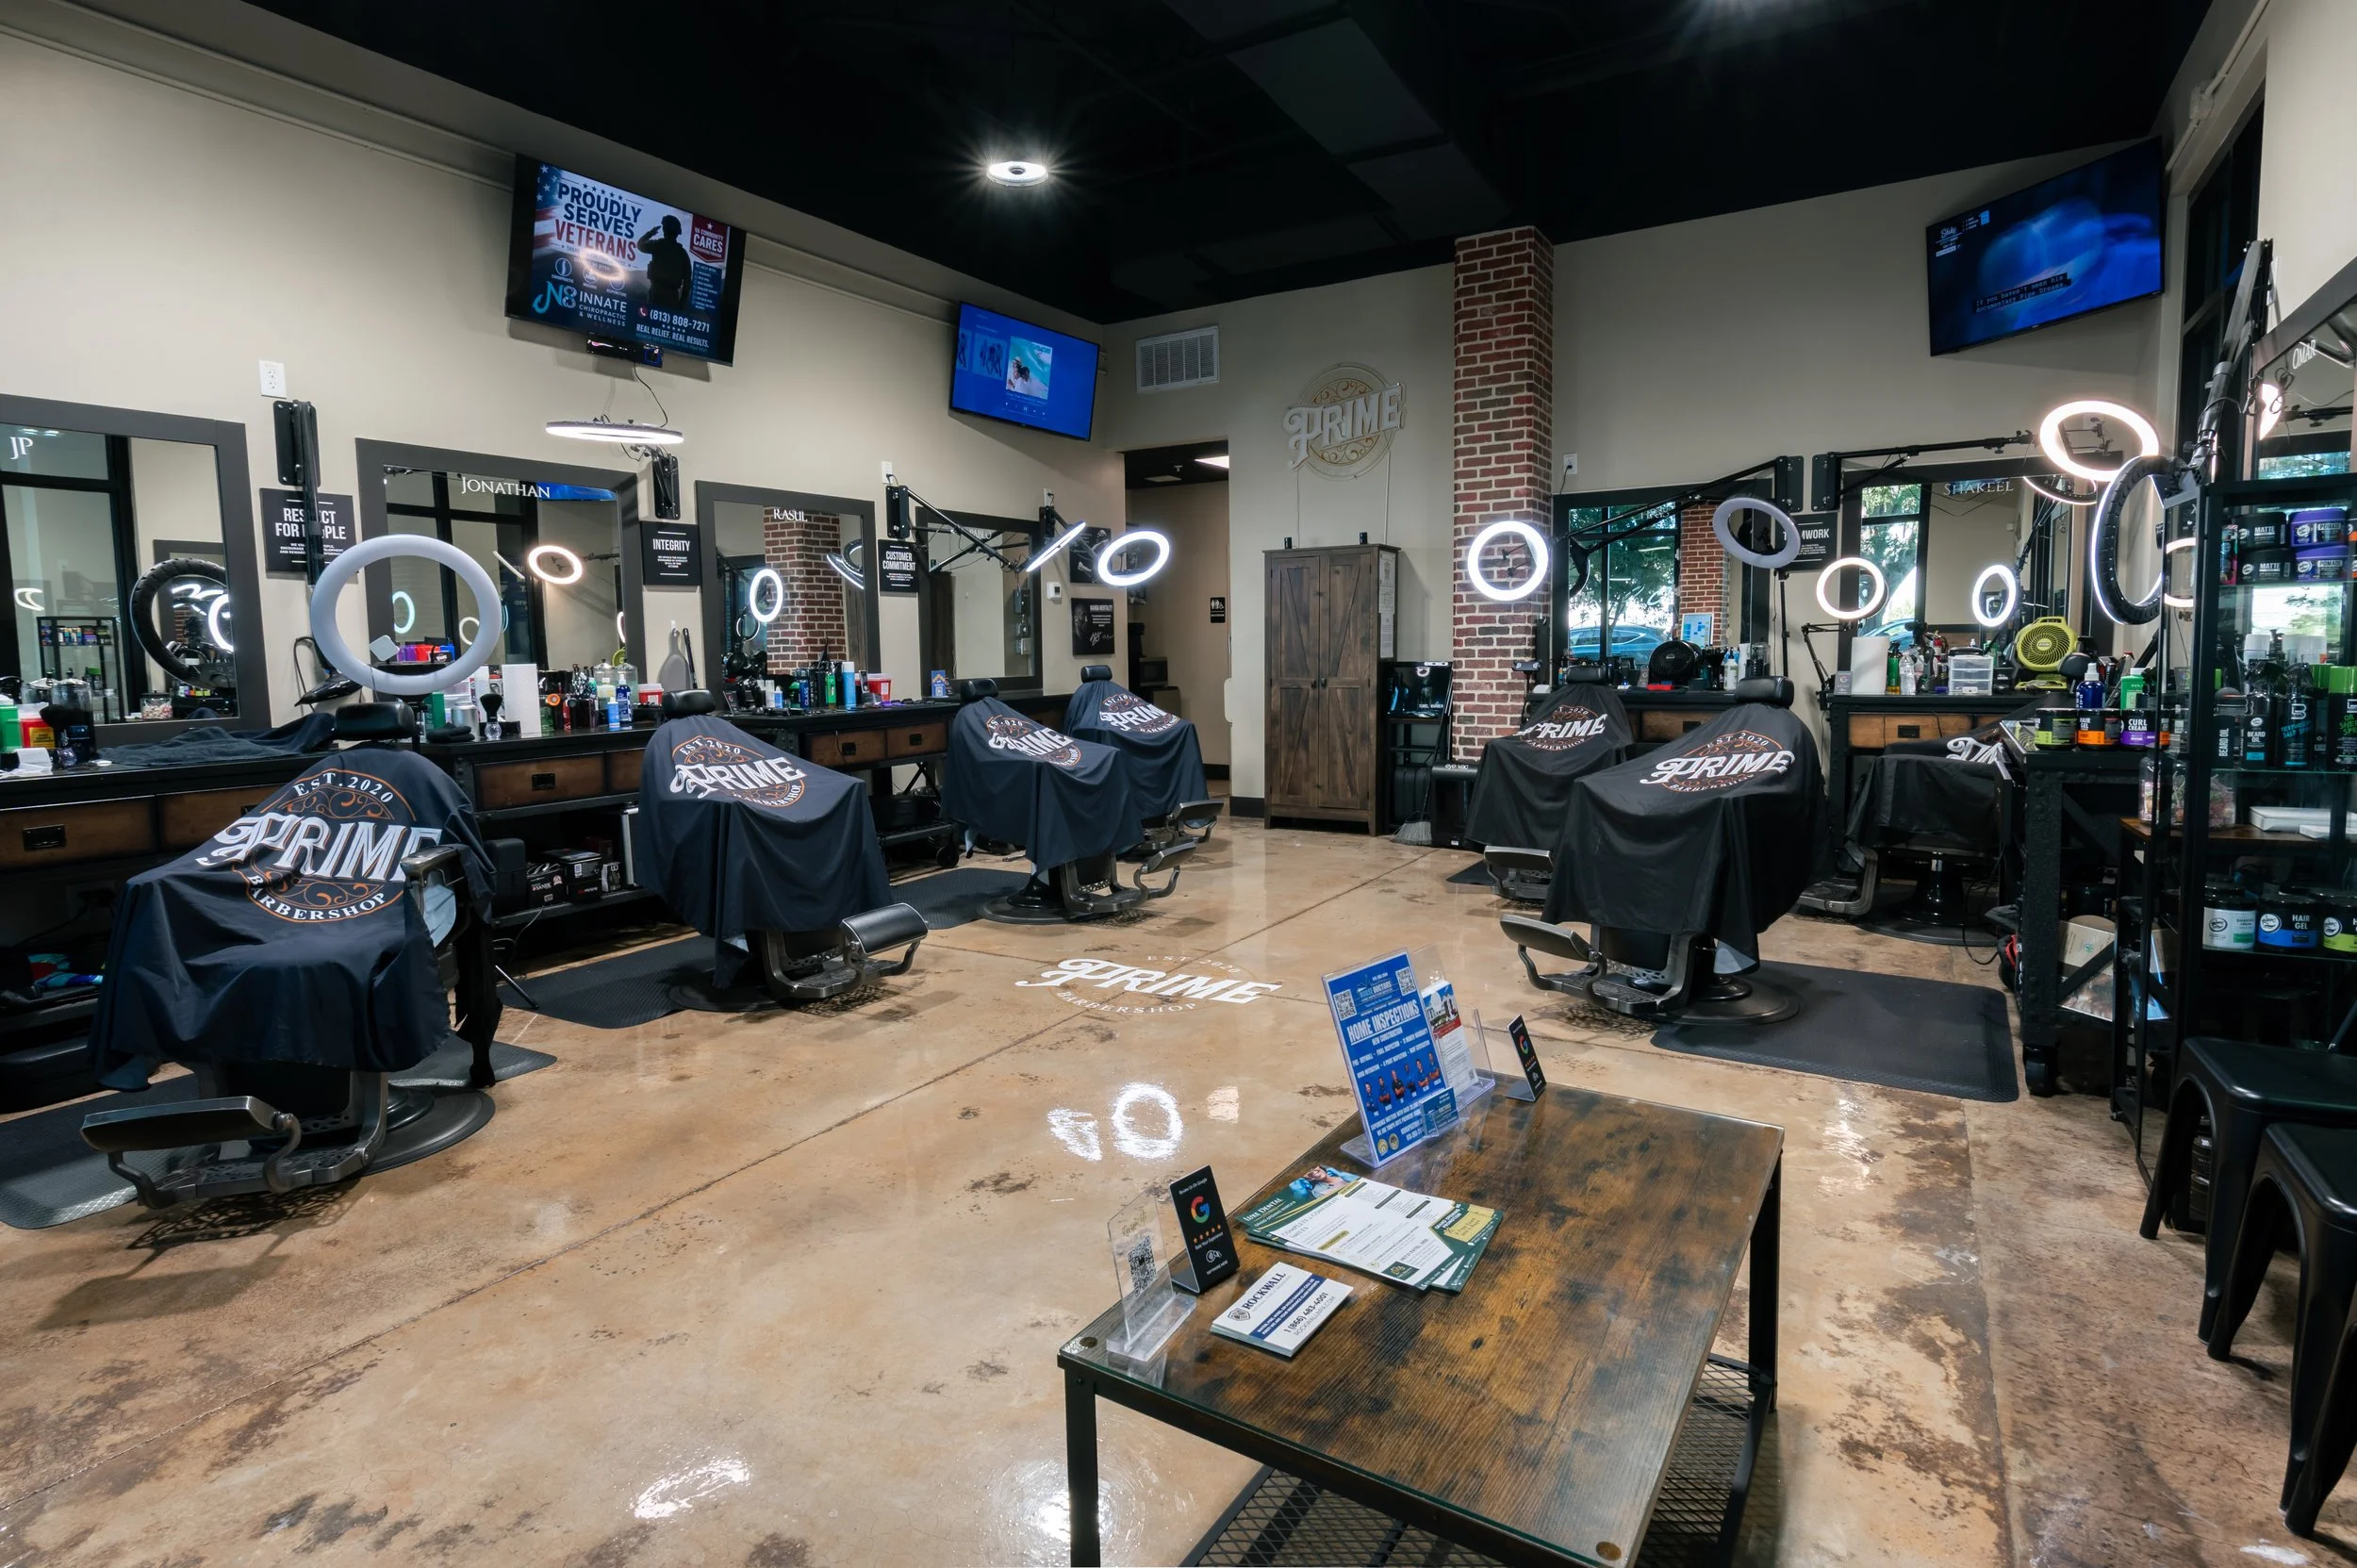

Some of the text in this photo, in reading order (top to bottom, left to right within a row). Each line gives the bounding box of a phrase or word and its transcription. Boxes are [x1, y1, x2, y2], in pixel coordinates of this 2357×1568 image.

[558, 182, 641, 223] PROUDLY
[564, 203, 635, 239] SERVES
[555, 219, 636, 261] VETERANS
[693, 234, 723, 254] CARES
[578, 304, 627, 321] CHIROPRACTIC
[580, 291, 627, 313] INNATE
[586, 313, 626, 327] WELLNESS
[650, 309, 710, 333] (813) 808-7271
[636, 324, 650, 334] REAL
[651, 327, 671, 339] RELIEF.
[672, 331, 685, 342] REAL
[687, 335, 709, 348] RESULTS.
[2292, 339, 2316, 370] OMAR
[1283, 382, 1402, 470] PRIME
[9, 437, 33, 460] JP
[461, 477, 550, 498] JONATHAN
[1943, 481, 2014, 496] SHAKEEL
[283, 507, 336, 525] RESCT
[774, 508, 808, 522] RASUL
[275, 522, 299, 537] FOR
[652, 538, 691, 552] INTEGRITY
[886, 551, 913, 561] CUSTOMER
[882, 560, 916, 571] COMMITMENT
[1099, 704, 1167, 731] PRIM
[2218, 728, 2229, 757] BEARD OIL
[670, 757, 807, 799] PRIME
[1640, 750, 1796, 784] PRIME
[195, 812, 442, 883] PRIME
[248, 875, 385, 920] BARBERSHOP
[2292, 914, 2310, 922] HAIR
[1014, 958, 1283, 1004] PRIME
[1373, 981, 1392, 993] DOCTORS
[1056, 991, 1196, 1014] BARBERSHOP
[1347, 1018, 1373, 1043] HOME
[1371, 999, 1420, 1032] INSPECTIONS
[1243, 1212, 1260, 1221] LUXE
[1258, 1198, 1283, 1213] DENTAL
[1241, 1272, 1286, 1310] ROCKWALL
[1286, 1315, 1307, 1330] (866)
[1300, 1291, 1329, 1315] 483-4001
